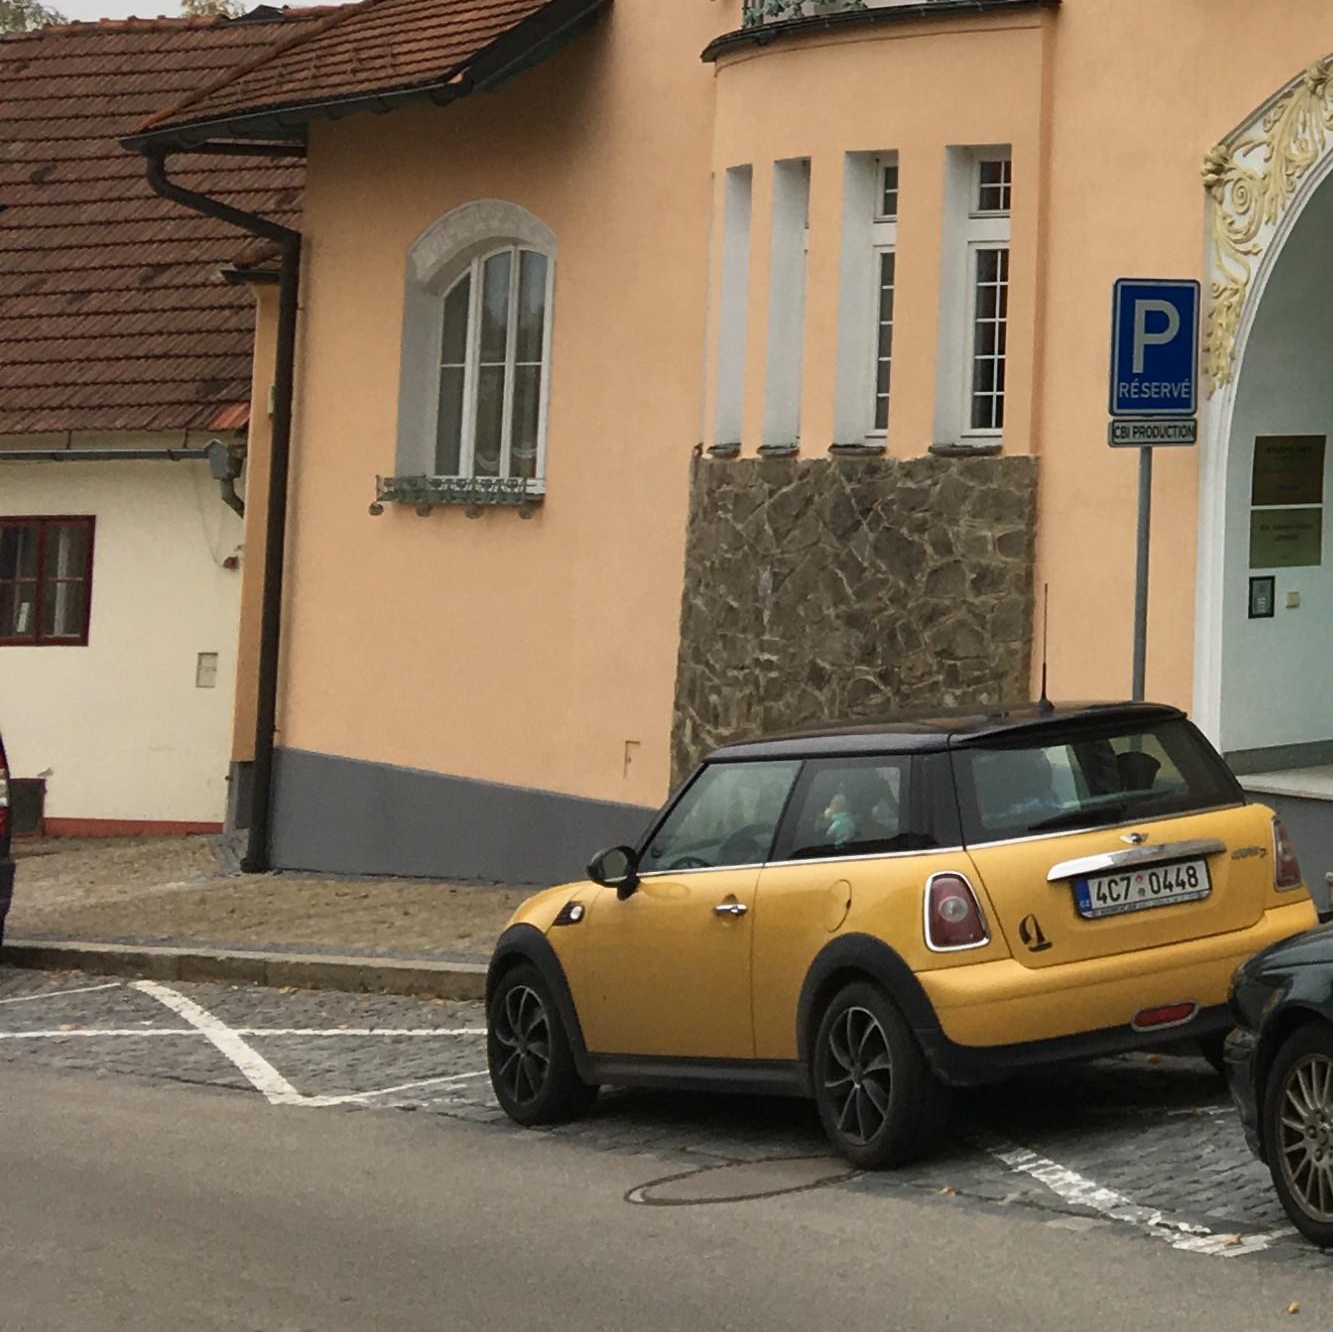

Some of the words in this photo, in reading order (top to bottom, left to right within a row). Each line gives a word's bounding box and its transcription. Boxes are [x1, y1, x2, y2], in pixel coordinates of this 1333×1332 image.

[1133, 299, 1180, 373] P
[1118, 379, 1191, 398] RÉSERVÉ
[1114, 426, 1130, 439] CBI
[1132, 425, 1194, 439] PRODUCTION
[1096, 876, 1131, 905] 4C7
[1148, 865, 1200, 895] 0448
